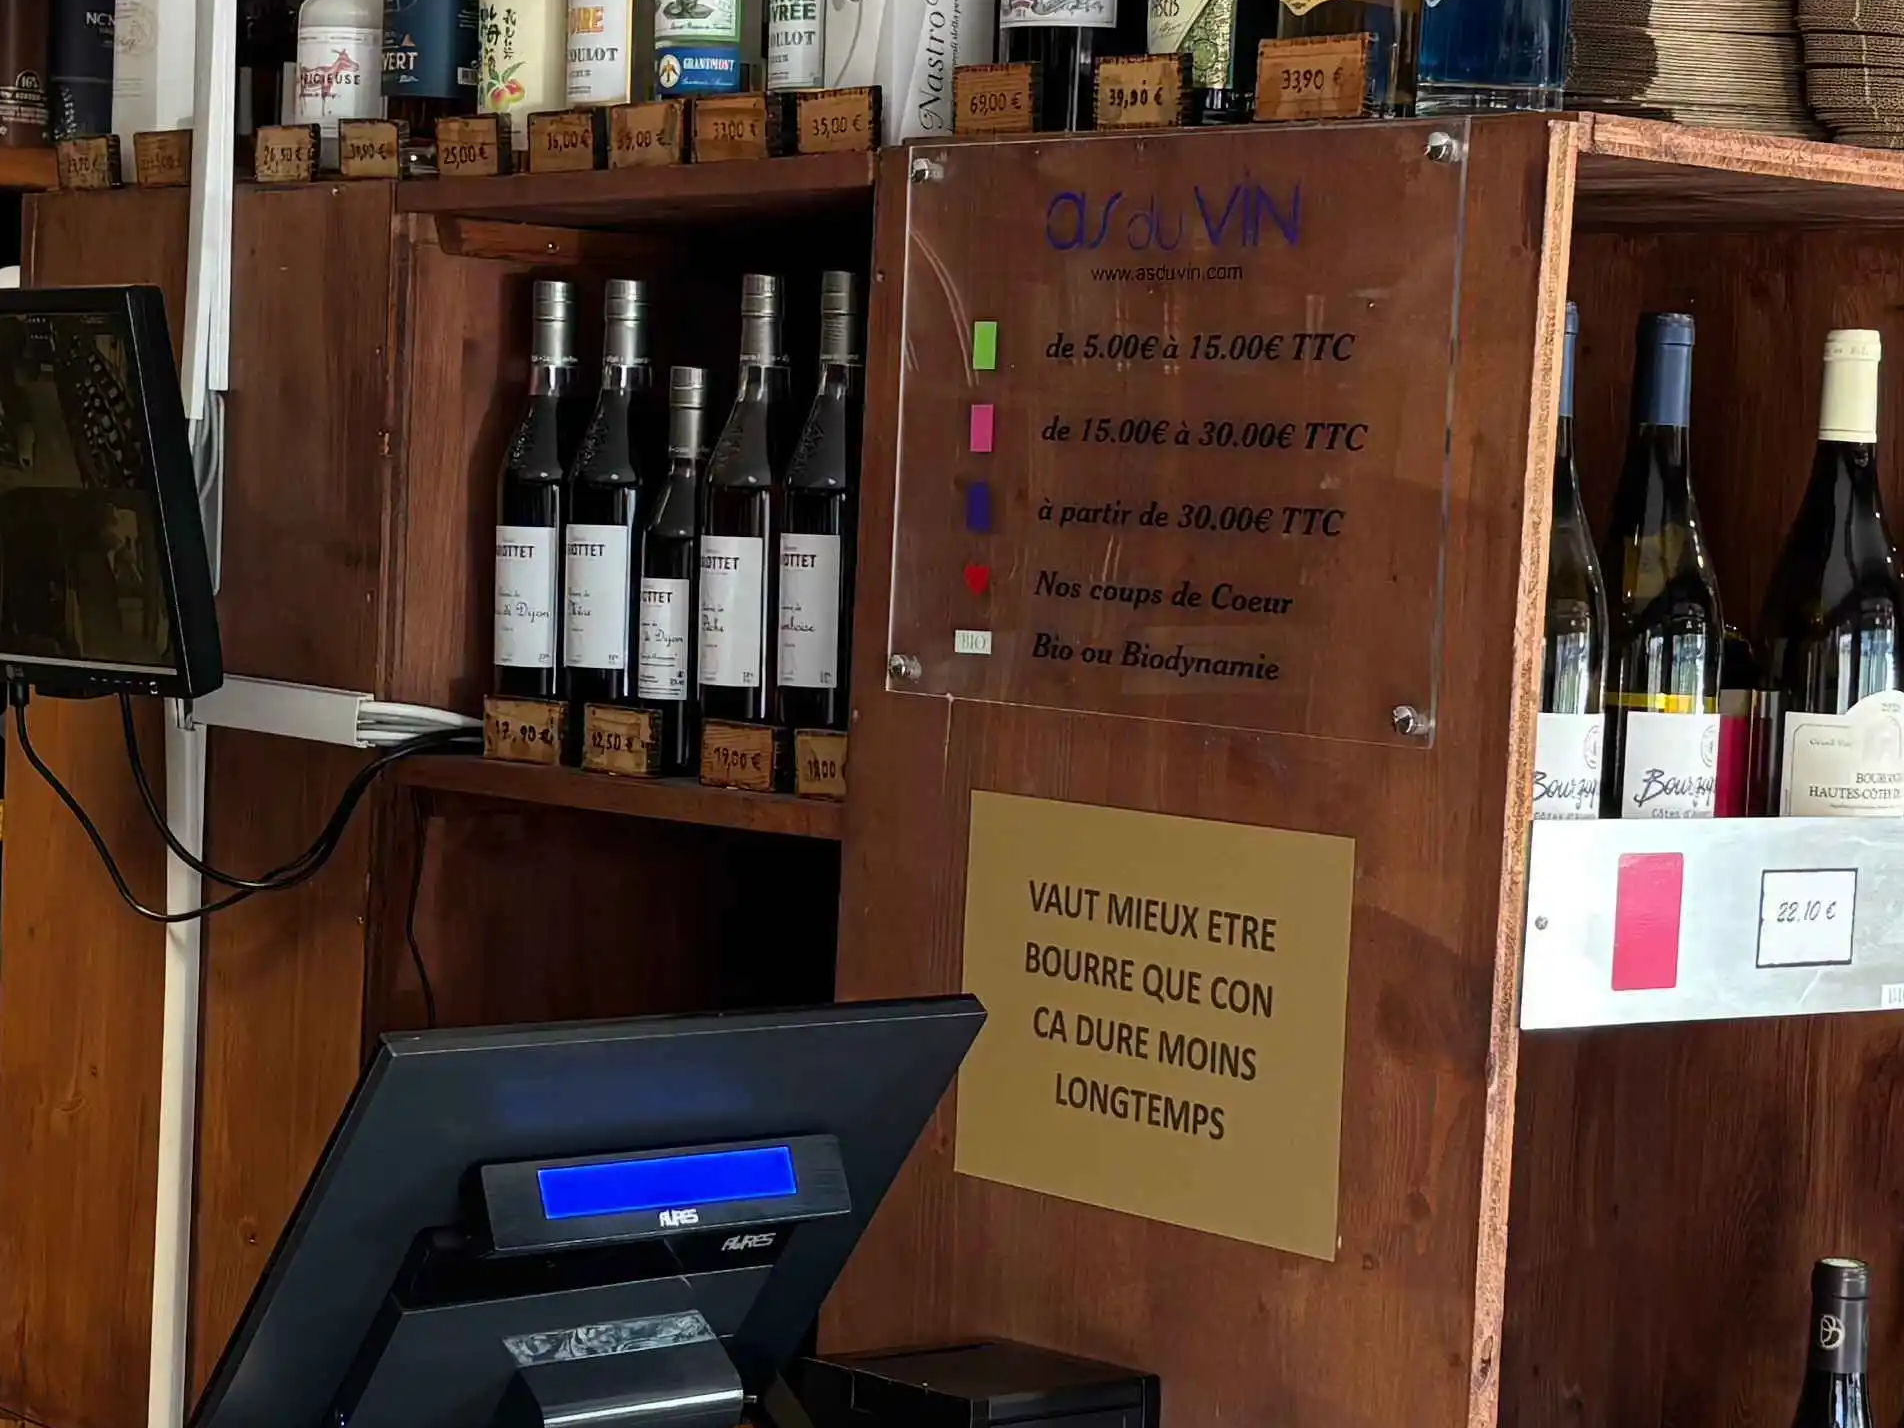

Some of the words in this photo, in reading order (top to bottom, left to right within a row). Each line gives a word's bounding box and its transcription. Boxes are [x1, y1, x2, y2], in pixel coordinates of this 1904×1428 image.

[1282, 67, 1324, 93] 33,90
[1090, 264, 1243, 282] www.asduvin.com
[1045, 332, 1076, 359] de
[1082, 332, 1159, 360] 5.00€
[1163, 332, 1179, 359] à
[1191, 332, 1284, 361] 15.00€
[1291, 332, 1356, 362] TTC
[1041, 418, 1071, 443] de
[1082, 419, 1170, 446] 15.00€
[1174, 421, 1191, 446] à
[1198, 420, 1296, 448] 30.00€
[1303, 422, 1368, 452] TTC
[1038, 498, 1052, 520] à
[1059, 500, 1133, 529] partir
[1138, 502, 1170, 529] de
[1177, 505, 1273, 534] 30.00€
[1281, 507, 1345, 537] TTC
[1034, 570, 1081, 599] Nos
[1090, 578, 1162, 608] coups
[1170, 580, 1203, 608] de
[1211, 583, 1294, 616] Coeur
[1032, 633, 1073, 660] Bio
[1081, 642, 1112, 665] ou
[1121, 641, 1280, 681] Biodynamie
[1028, 879, 1100, 922] VAUT
[1107, 892, 1200, 940] MIEUX
[1208, 909, 1277, 952] ETRE
[1025, 941, 1134, 992] BOURRE
[1142, 964, 1201, 1006] QUE
[1210, 976, 1273, 1018] CON
[1033, 1006, 1067, 1044] CA
[1076, 1013, 1150, 1060] DURE
[1158, 1030, 1258, 1082] MOINS
[1055, 1073, 1226, 1140] LONGTEMPS
